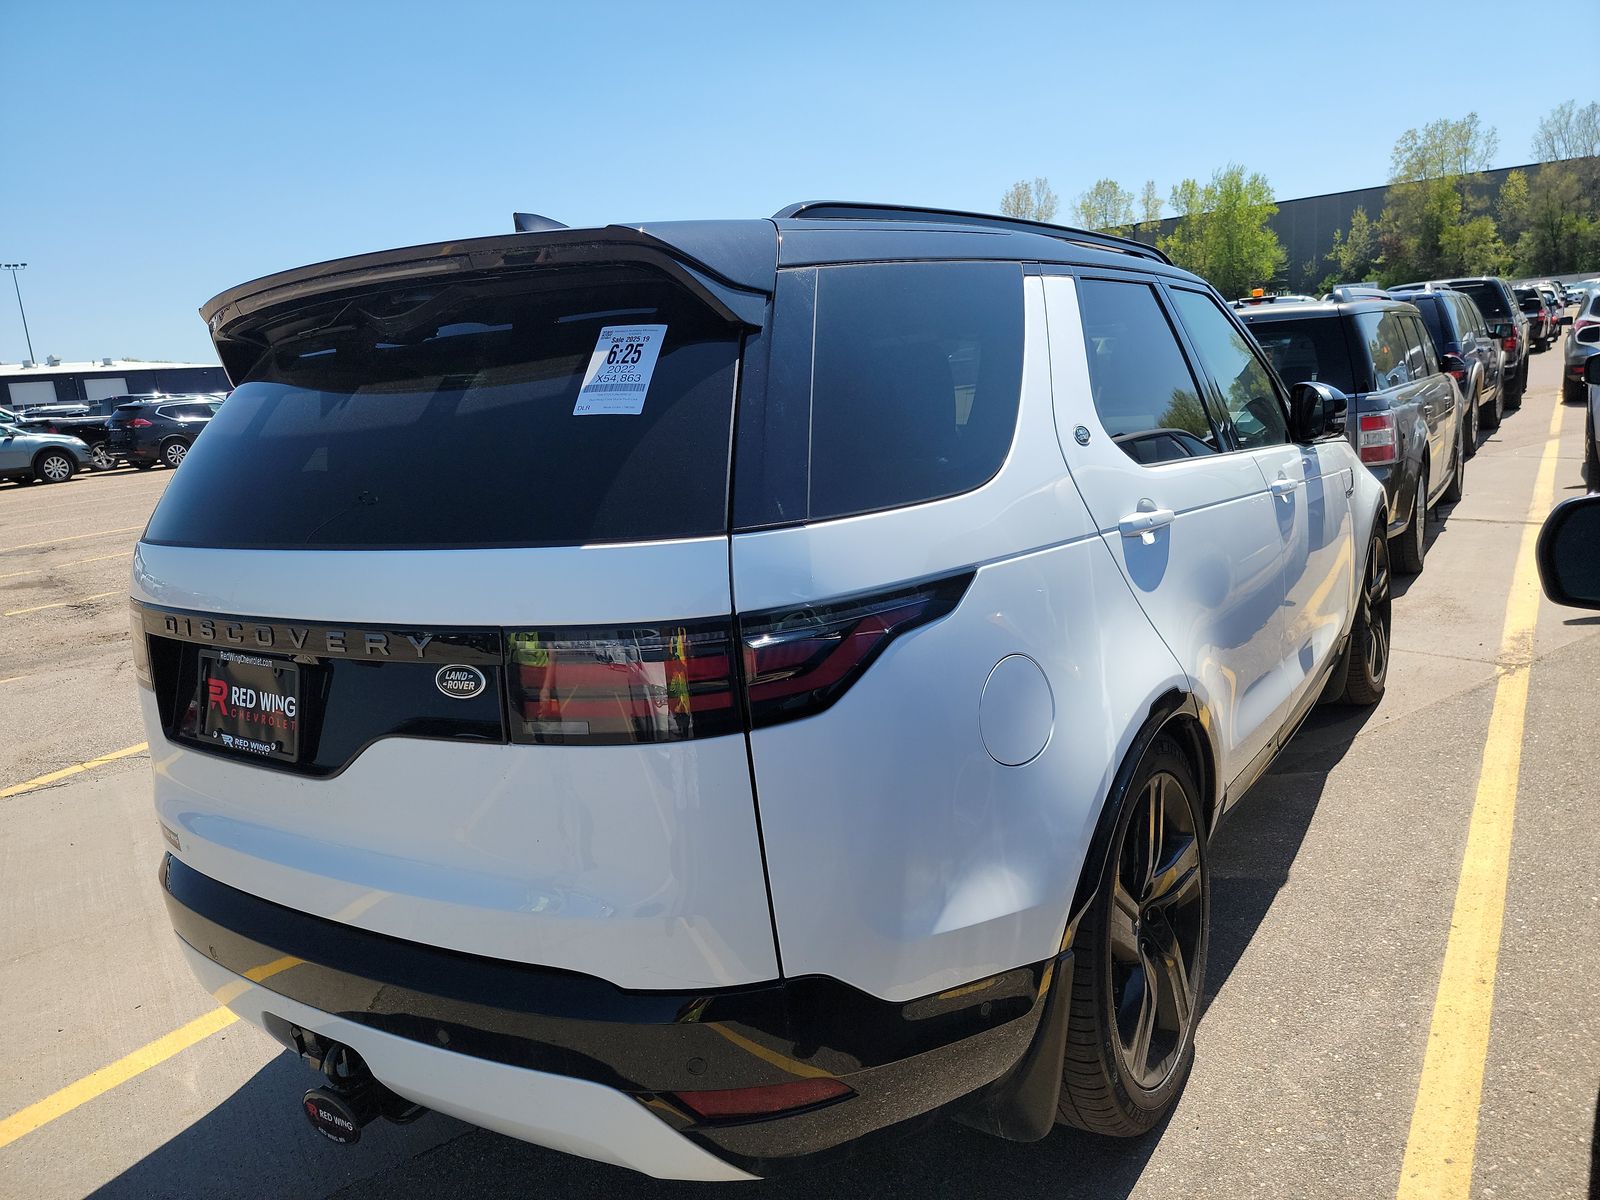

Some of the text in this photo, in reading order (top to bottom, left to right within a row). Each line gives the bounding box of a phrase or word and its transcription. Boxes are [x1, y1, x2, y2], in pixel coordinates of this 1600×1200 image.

[606, 343, 643, 364] 6:25
[607, 365, 636, 373] 2022
[164, 615, 433, 658] DISCOVERY
[220, 651, 273, 668] RedWingChevrolet.com
[445, 670, 468, 681] LAND
[447, 680, 475, 690] ROVER
[231, 686, 296, 717] RED WING
[231, 708, 297, 731] CHEVROLET
[234, 738, 249, 747] RED
[250, 742, 270, 753] WING
[319, 1109, 353, 1130] RED WING
